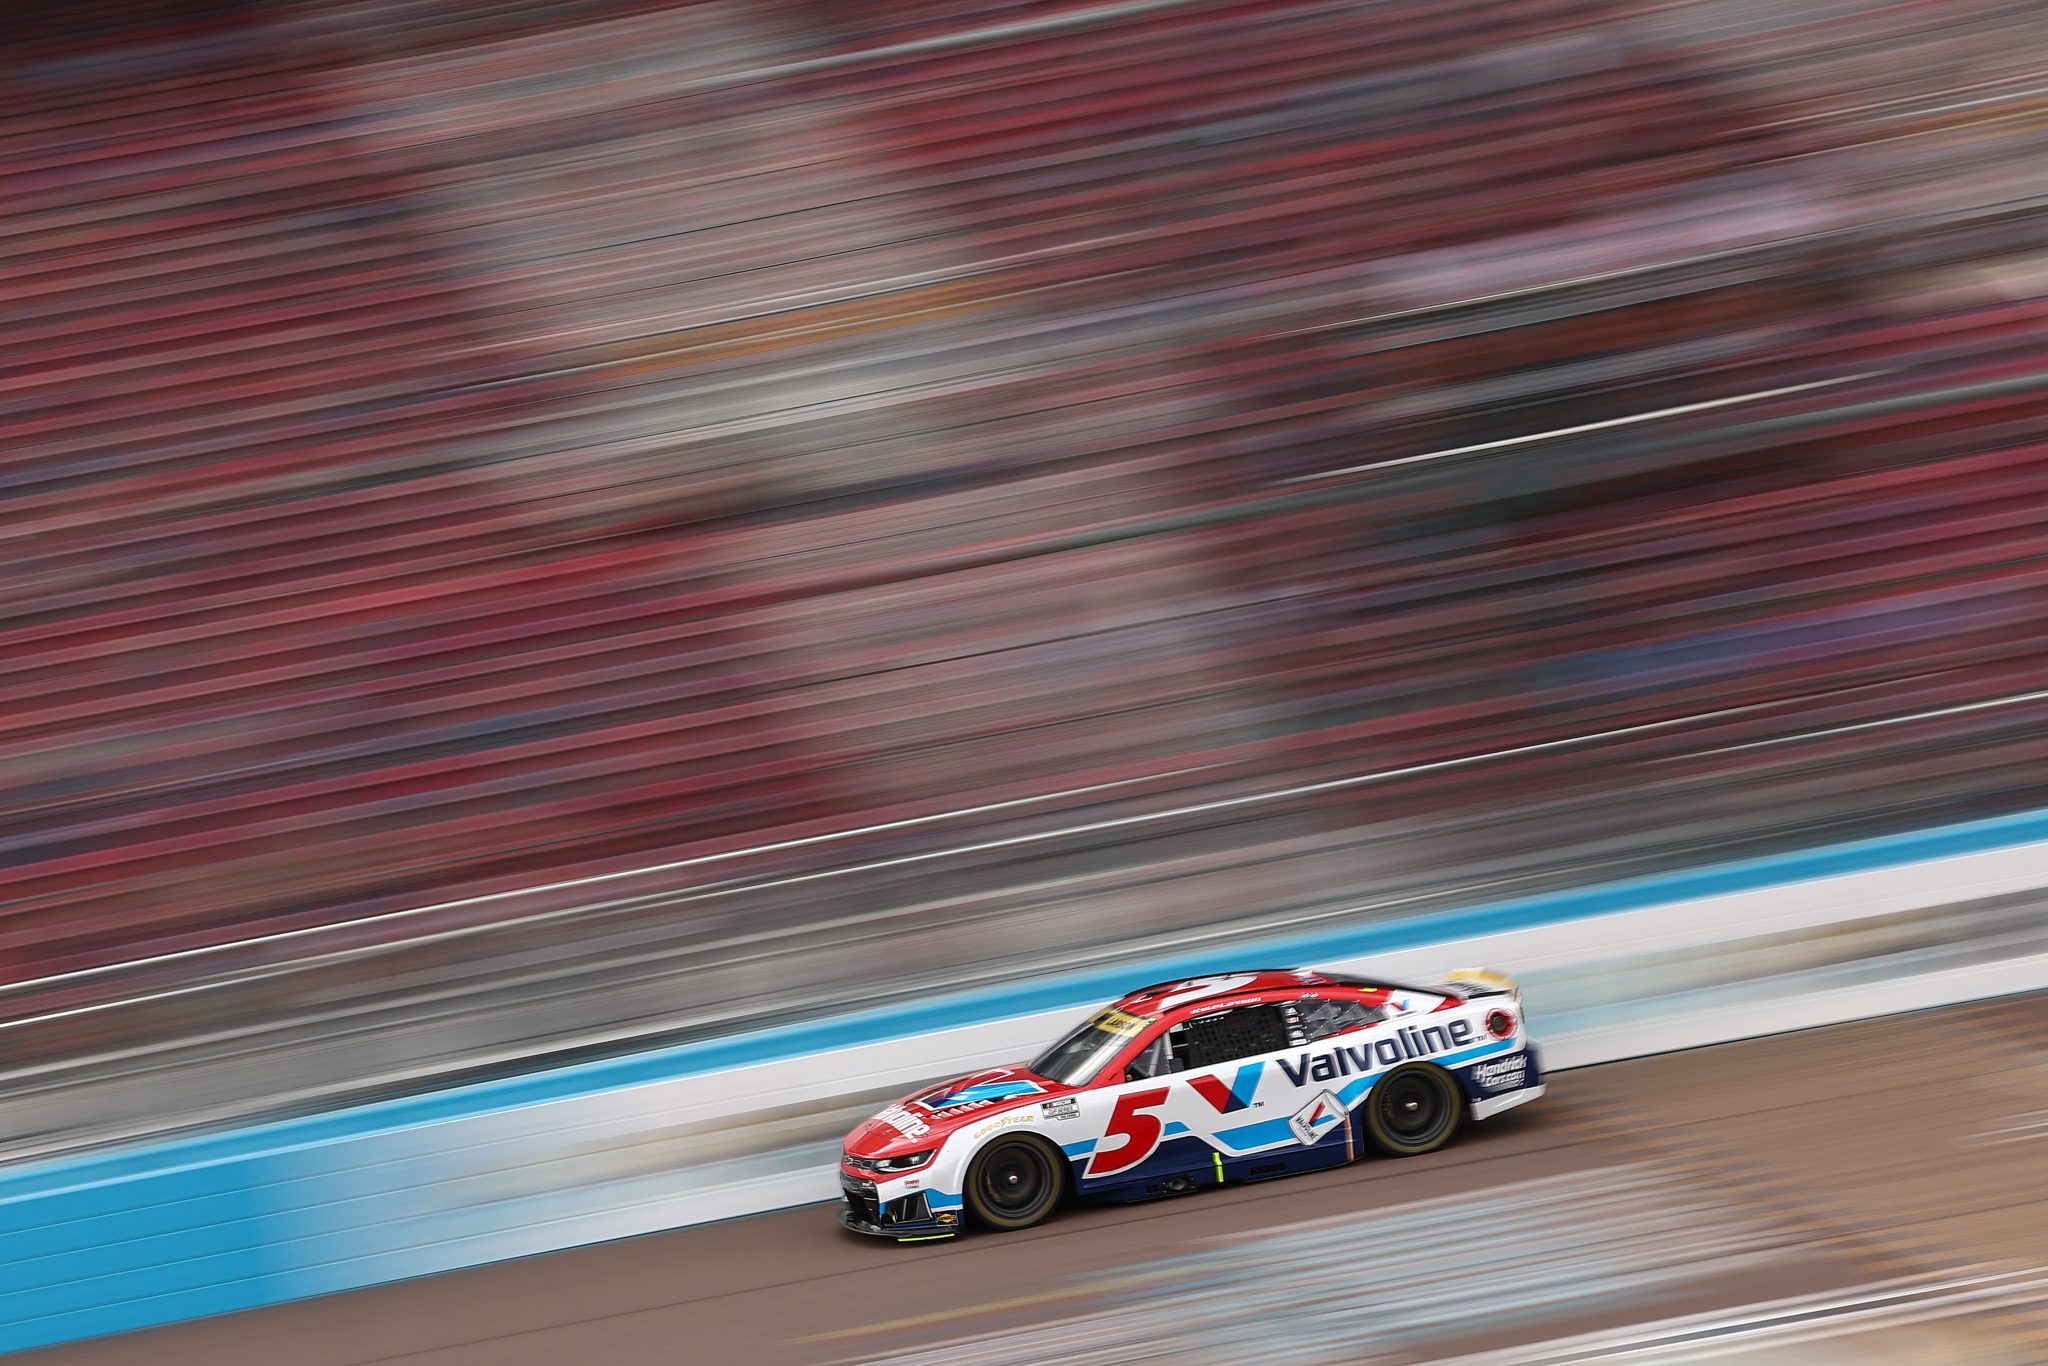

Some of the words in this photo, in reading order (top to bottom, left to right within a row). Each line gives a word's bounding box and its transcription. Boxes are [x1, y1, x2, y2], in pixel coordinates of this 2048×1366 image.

[1276, 1018, 1474, 1088] Valvoline
[1473, 1054, 1528, 1083] Hendrick
[973, 1115, 1035, 1139] GOODYEAR
[1083, 1086, 1171, 1179] 5
[1295, 1116, 1320, 1141] VALVOLINE
